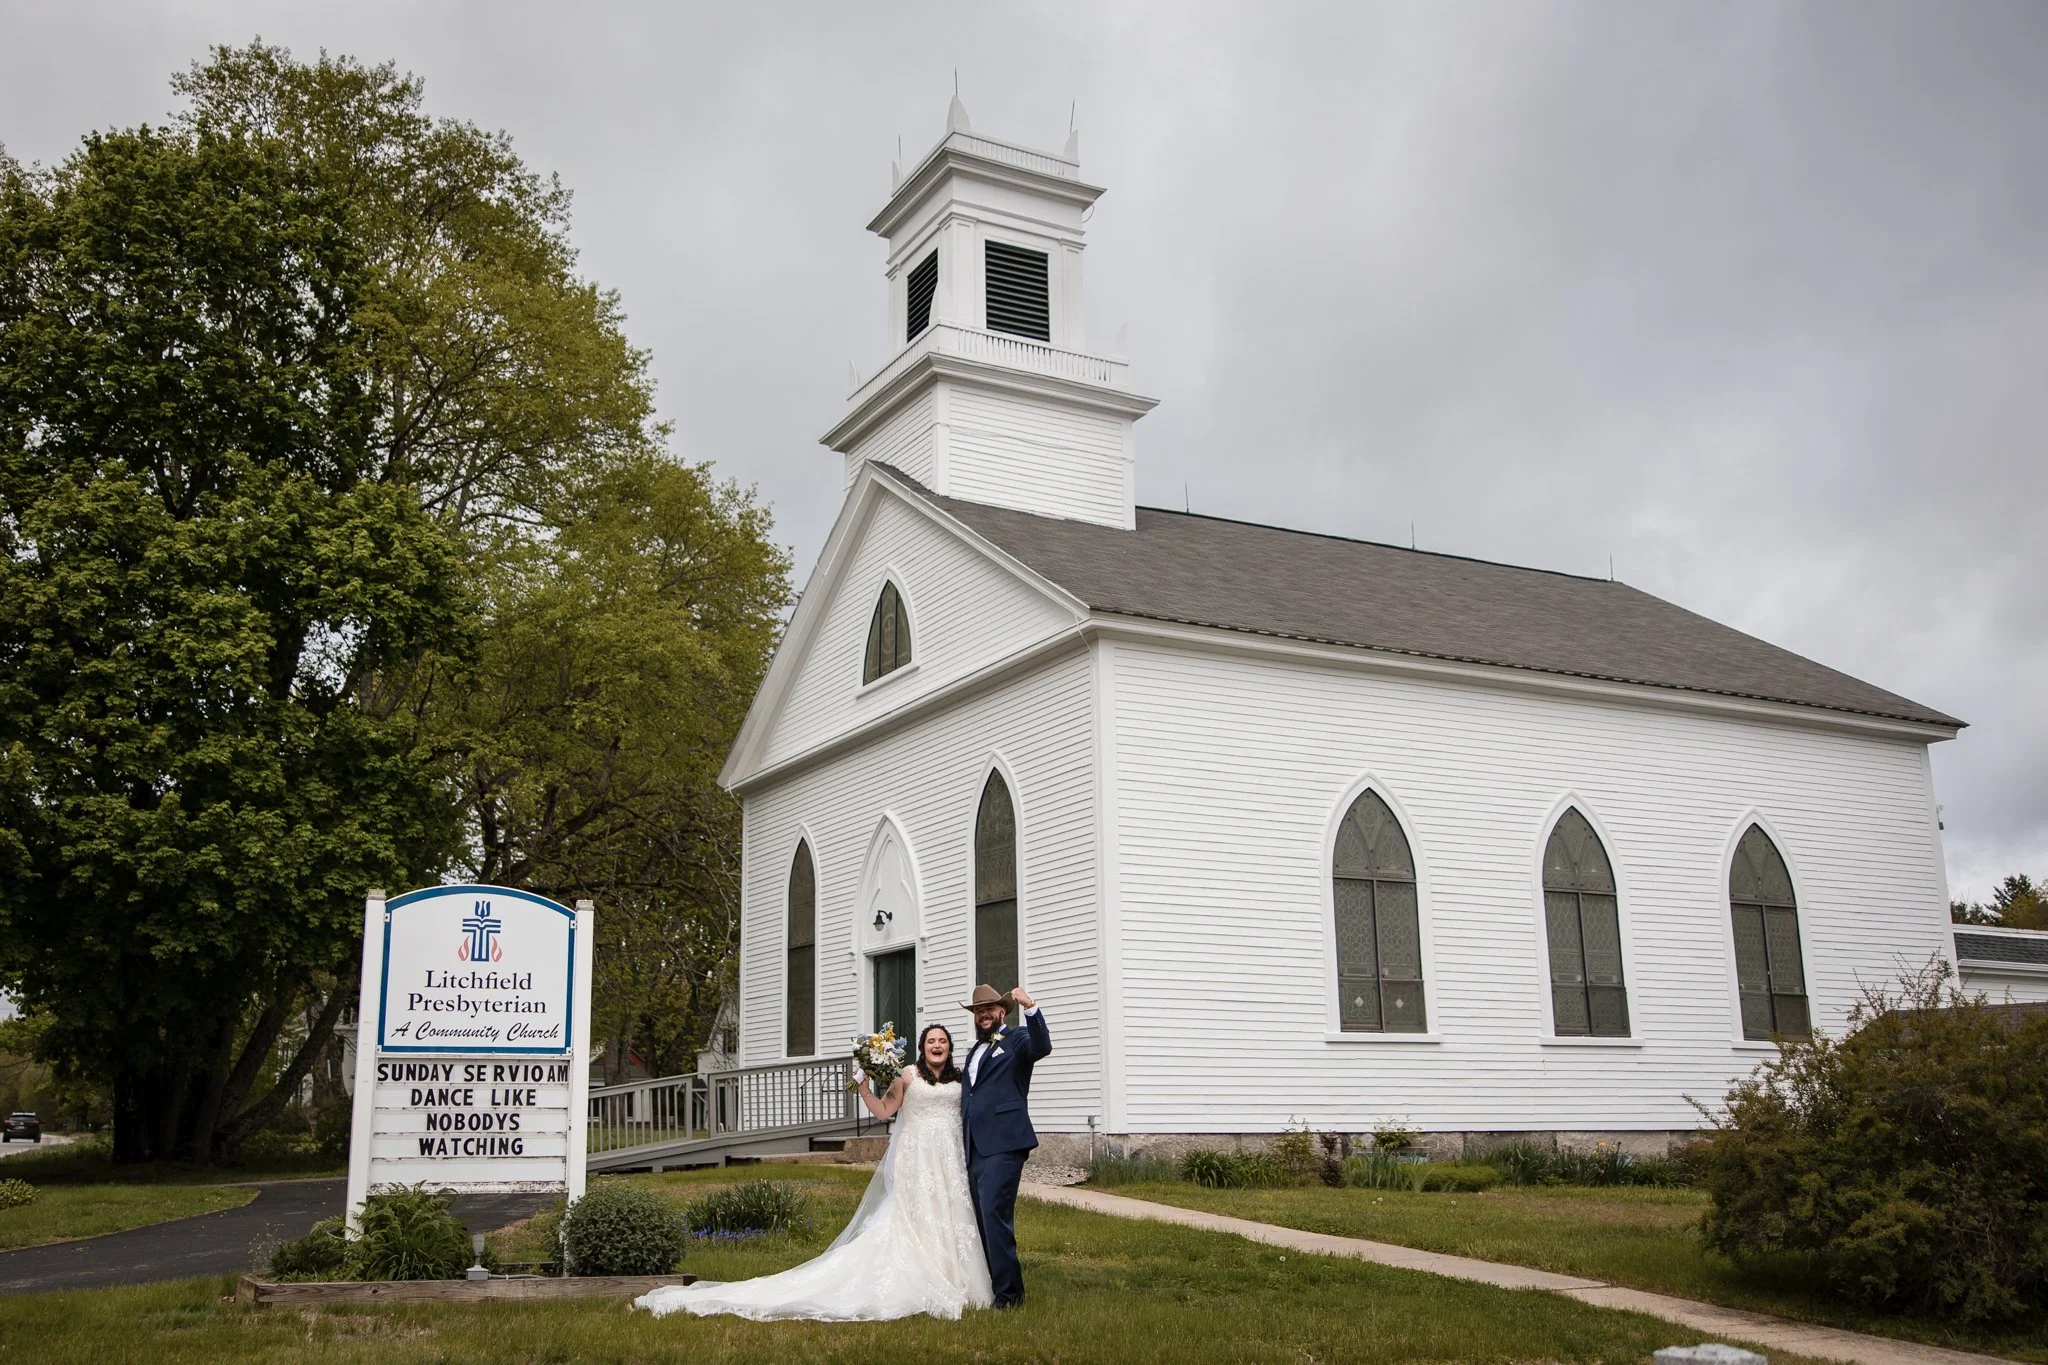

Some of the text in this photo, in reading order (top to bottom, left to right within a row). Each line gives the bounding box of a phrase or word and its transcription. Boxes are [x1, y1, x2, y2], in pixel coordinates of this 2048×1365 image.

[424, 969, 532, 990] Litchfield
[407, 993, 546, 1019] Presbyterian
[391, 1020, 560, 1042] A Community Church
[377, 1063, 455, 1082] SUNDAY
[411, 1088, 537, 1107] DANCE LIKE
[426, 1113, 520, 1131] NOBODYS
[418, 1137, 524, 1156] WATCHING
